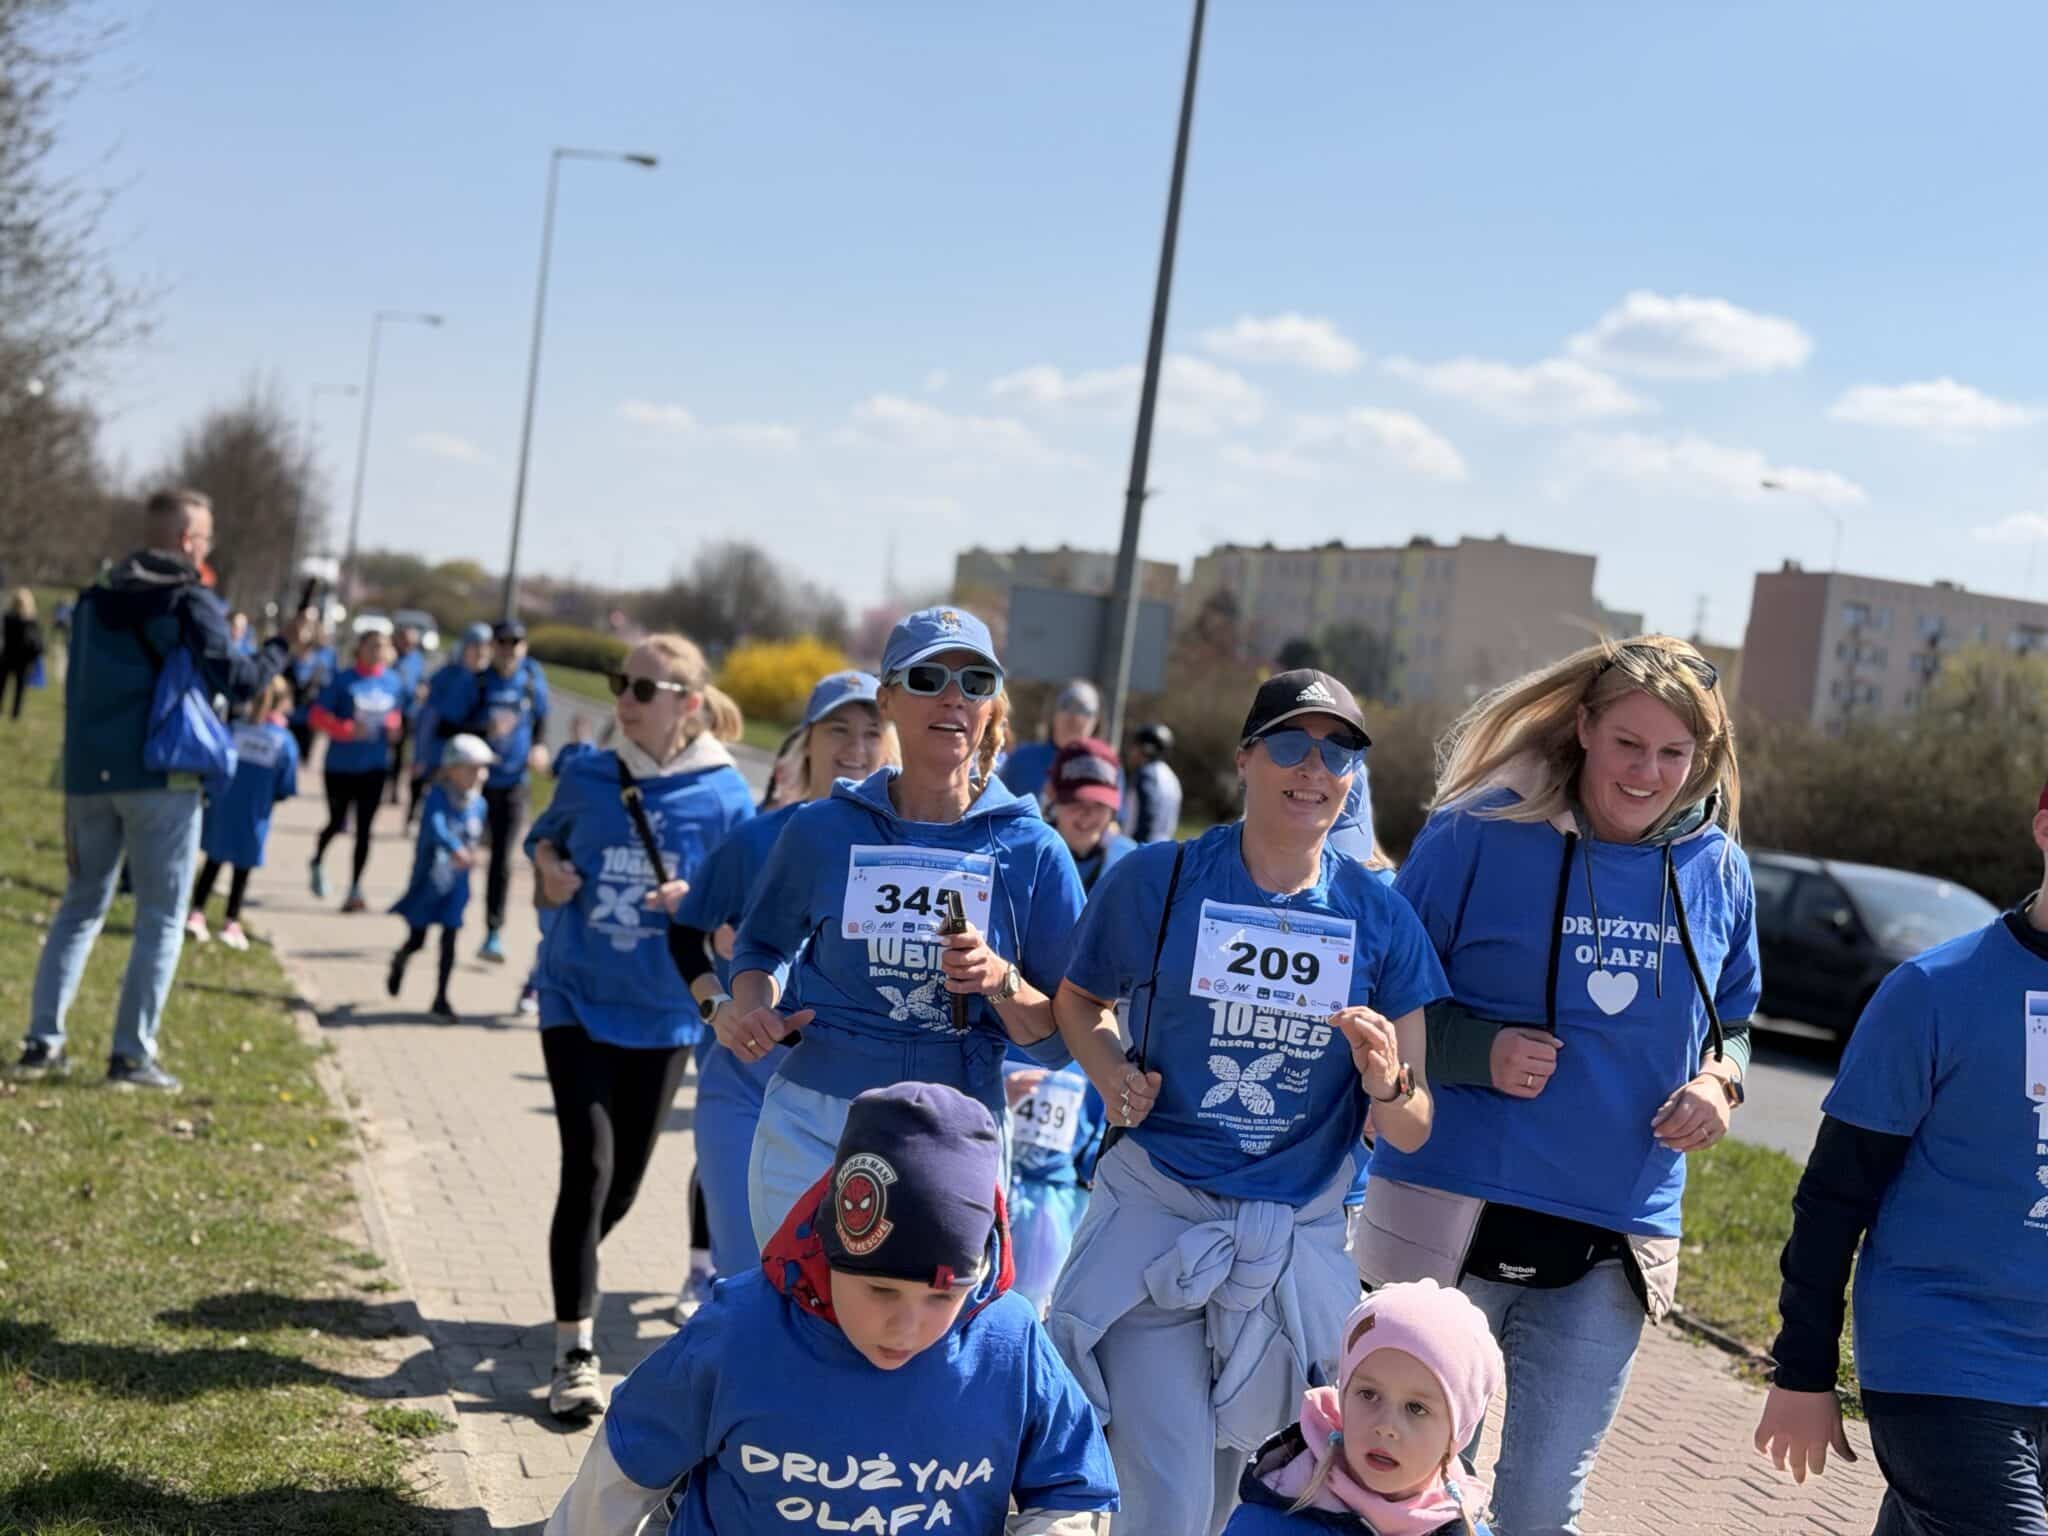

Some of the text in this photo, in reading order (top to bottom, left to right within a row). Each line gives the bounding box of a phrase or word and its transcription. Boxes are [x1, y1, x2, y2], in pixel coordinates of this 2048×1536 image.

[1562, 916, 1682, 944] DRUŻYNA
[869, 965, 909, 979] Razem
[1227, 942, 1320, 985] 209
[1575, 945, 1658, 970] OLAFA
[1208, 1001, 1332, 1047] 10 BIEG
[1209, 1038, 1255, 1049] Razem
[1258, 1041, 1276, 1050] od
[1016, 1098, 1065, 1129] 439
[741, 1444, 994, 1493] DRUŻYNA
[776, 1497, 951, 1536] OLAFA
